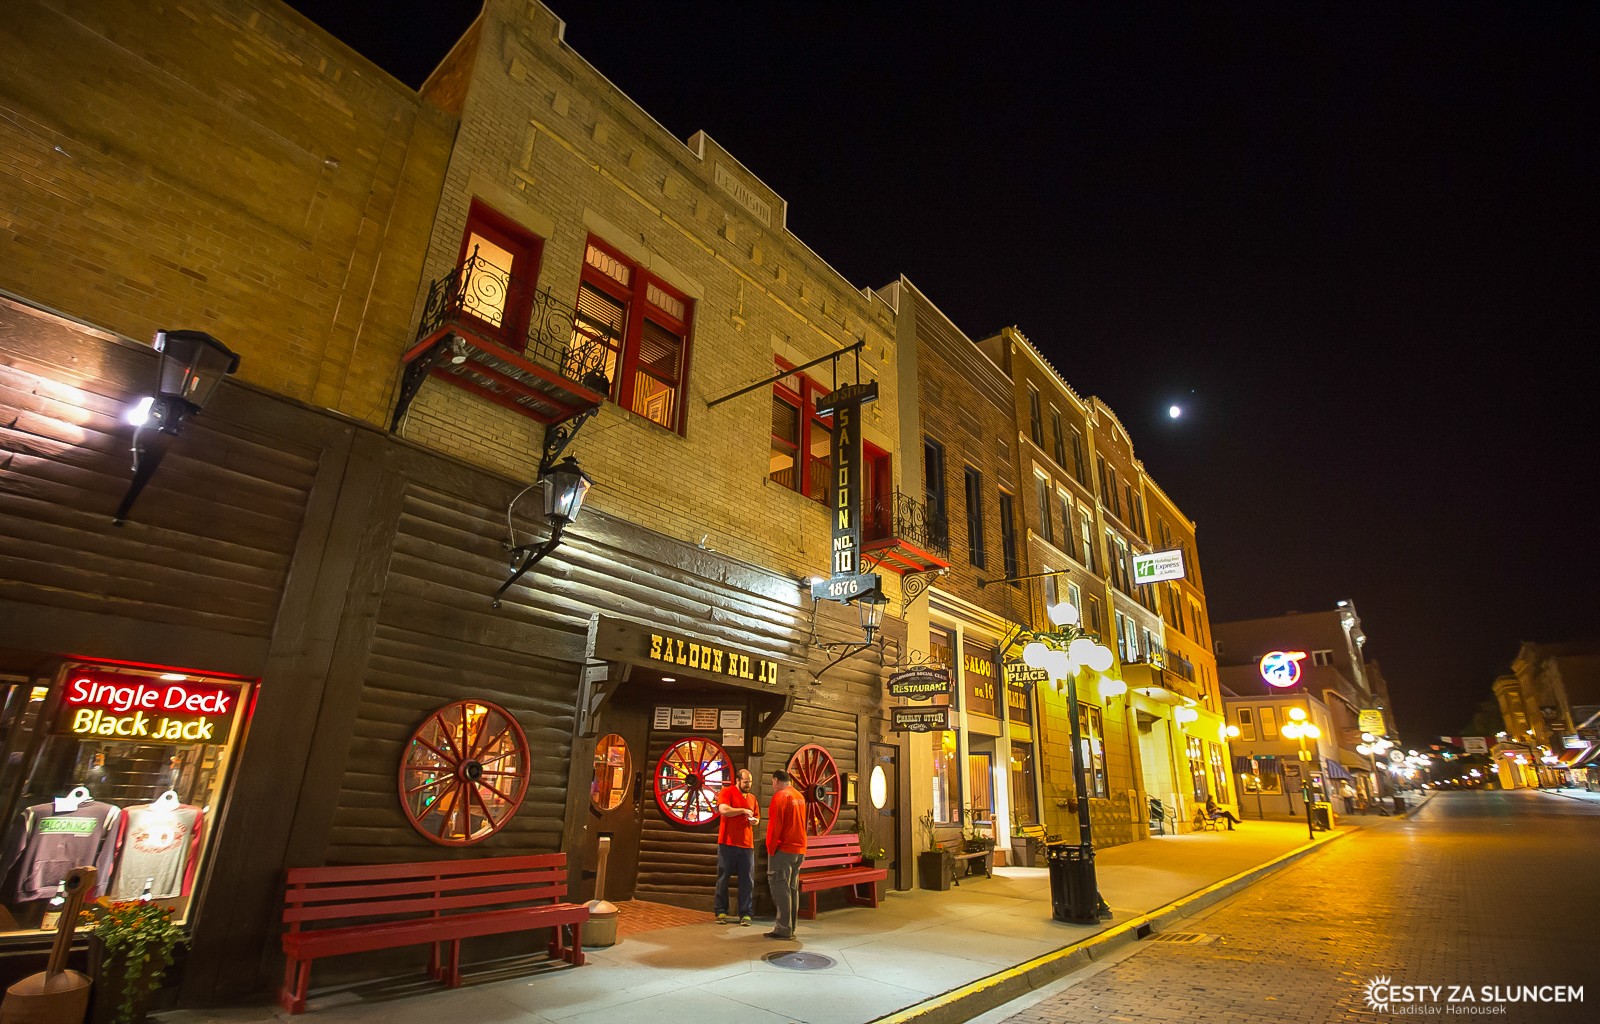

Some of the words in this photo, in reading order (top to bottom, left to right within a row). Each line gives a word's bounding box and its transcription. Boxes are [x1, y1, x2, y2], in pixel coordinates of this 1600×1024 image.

[839, 409, 849, 529] SALOON
[834, 535, 853, 550] NO.
[834, 550, 852, 573] 10
[828, 579, 858, 597] 1876
[650, 634, 723, 672] SALOON
[728, 652, 754, 680] NO.
[759, 660, 778, 684] 10
[965, 654, 996, 678] SALOON
[1008, 663, 1045, 672] UTT
[1008, 671, 1045, 681] PLACE
[164, 685, 231, 714] Deck
[984, 682, 994, 700] 10
[72, 708, 149, 737] Black
[152, 717, 212, 740] Jack
[923, 712, 945, 723] UTTER
